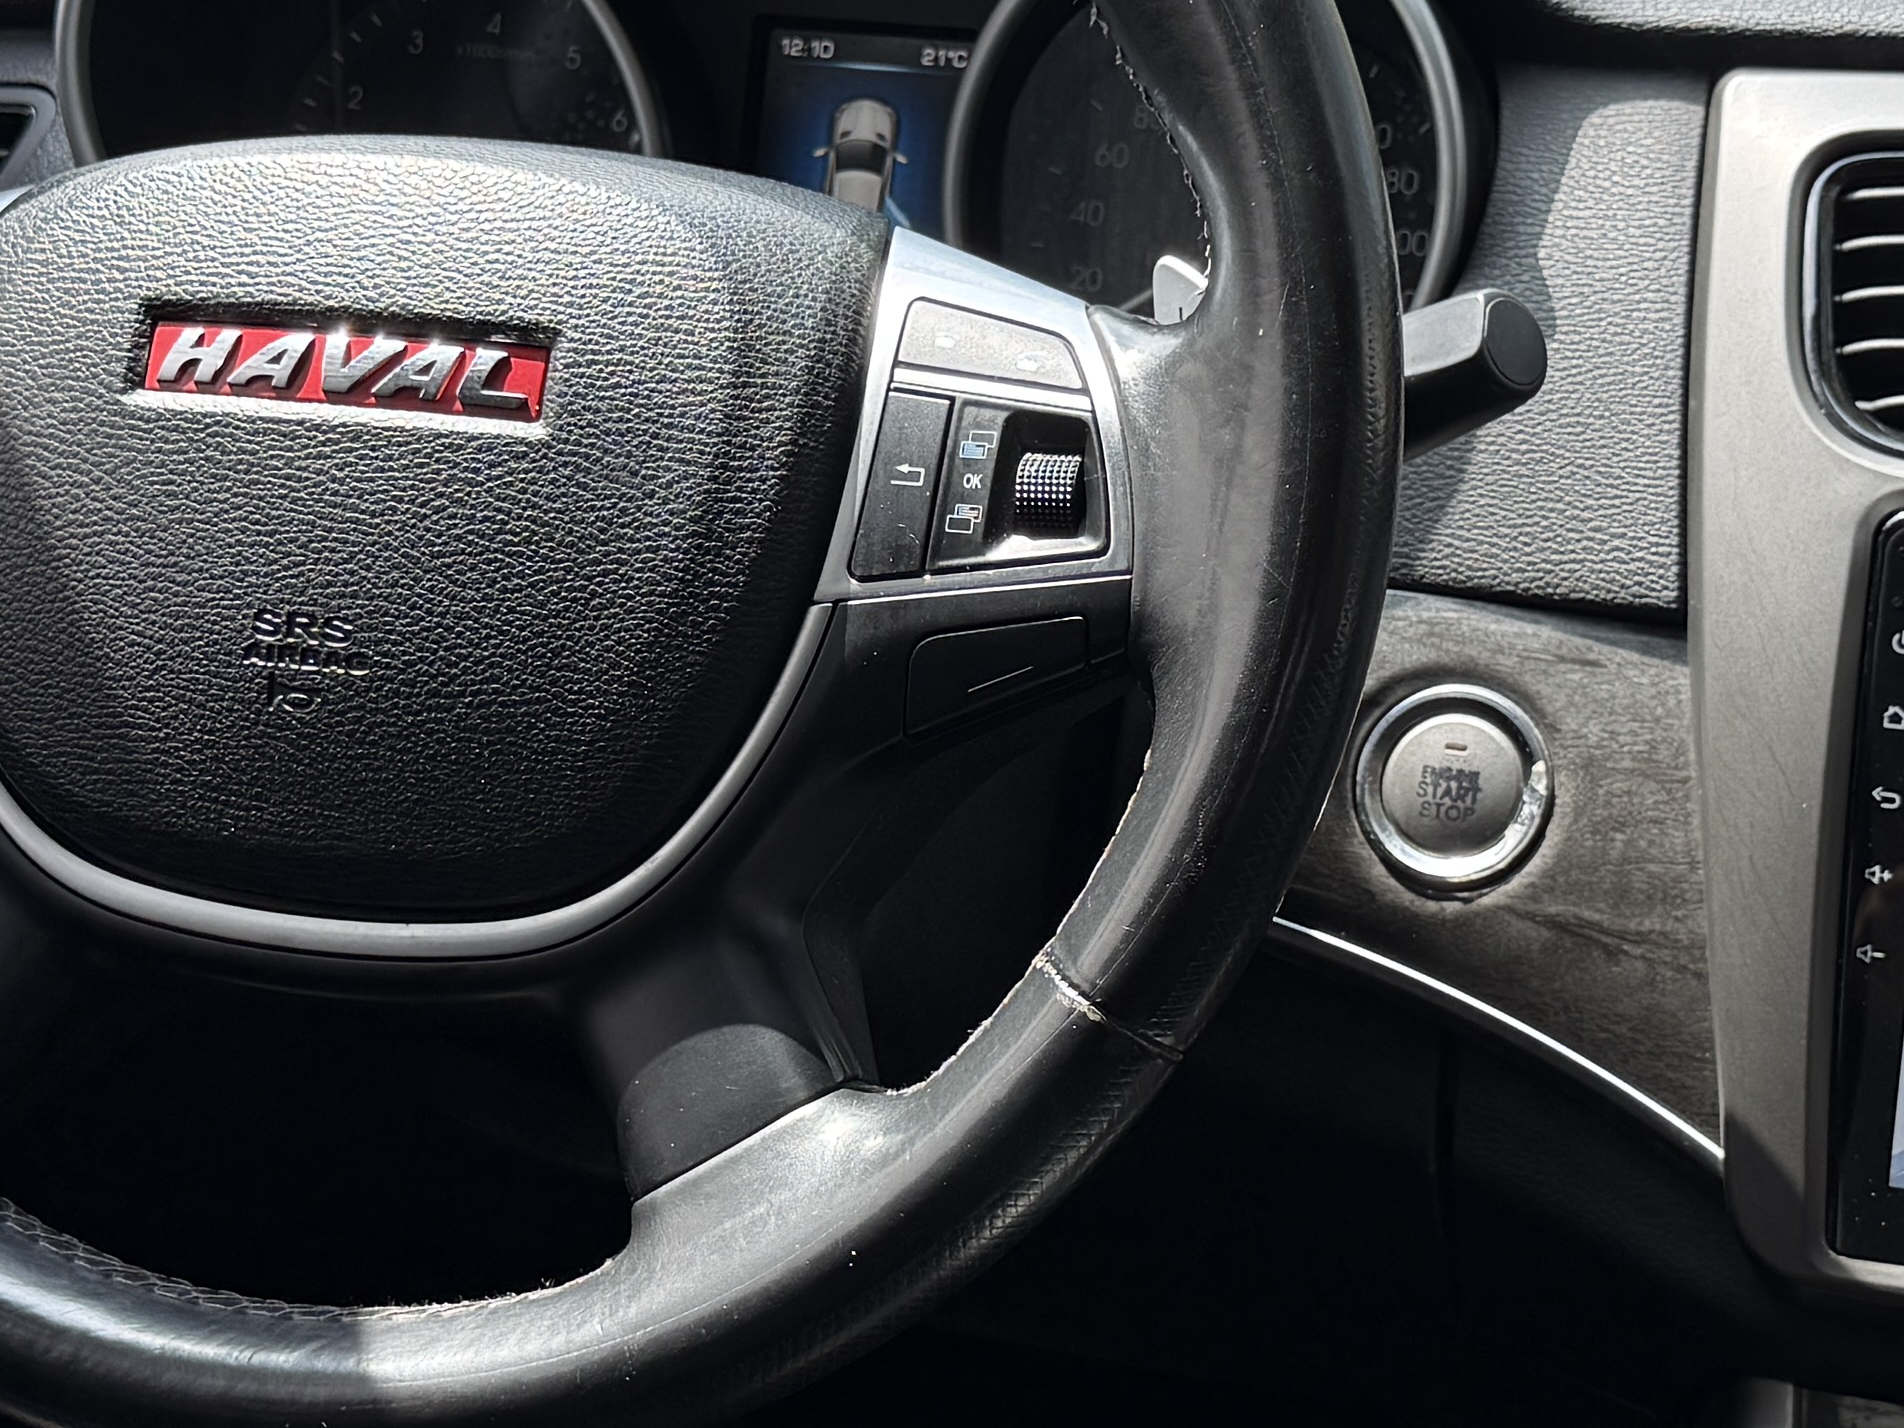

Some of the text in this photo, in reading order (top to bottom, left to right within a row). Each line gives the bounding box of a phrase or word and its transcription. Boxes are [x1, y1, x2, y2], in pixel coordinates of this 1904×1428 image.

[407, 28, 424, 54] 3
[781, 37, 835, 59] 12:10
[564, 45, 581, 70] 5
[347, 85, 364, 110] 2
[611, 109, 628, 133] 6
[1095, 141, 1129, 169] 60
[1069, 199, 1105, 228] 40
[157, 327, 531, 410] HAVAL
[962, 472, 983, 490] OK
[253, 608, 354, 648] SRS
[1416, 778, 1482, 806] START
[1418, 800, 1475, 822] STOP
